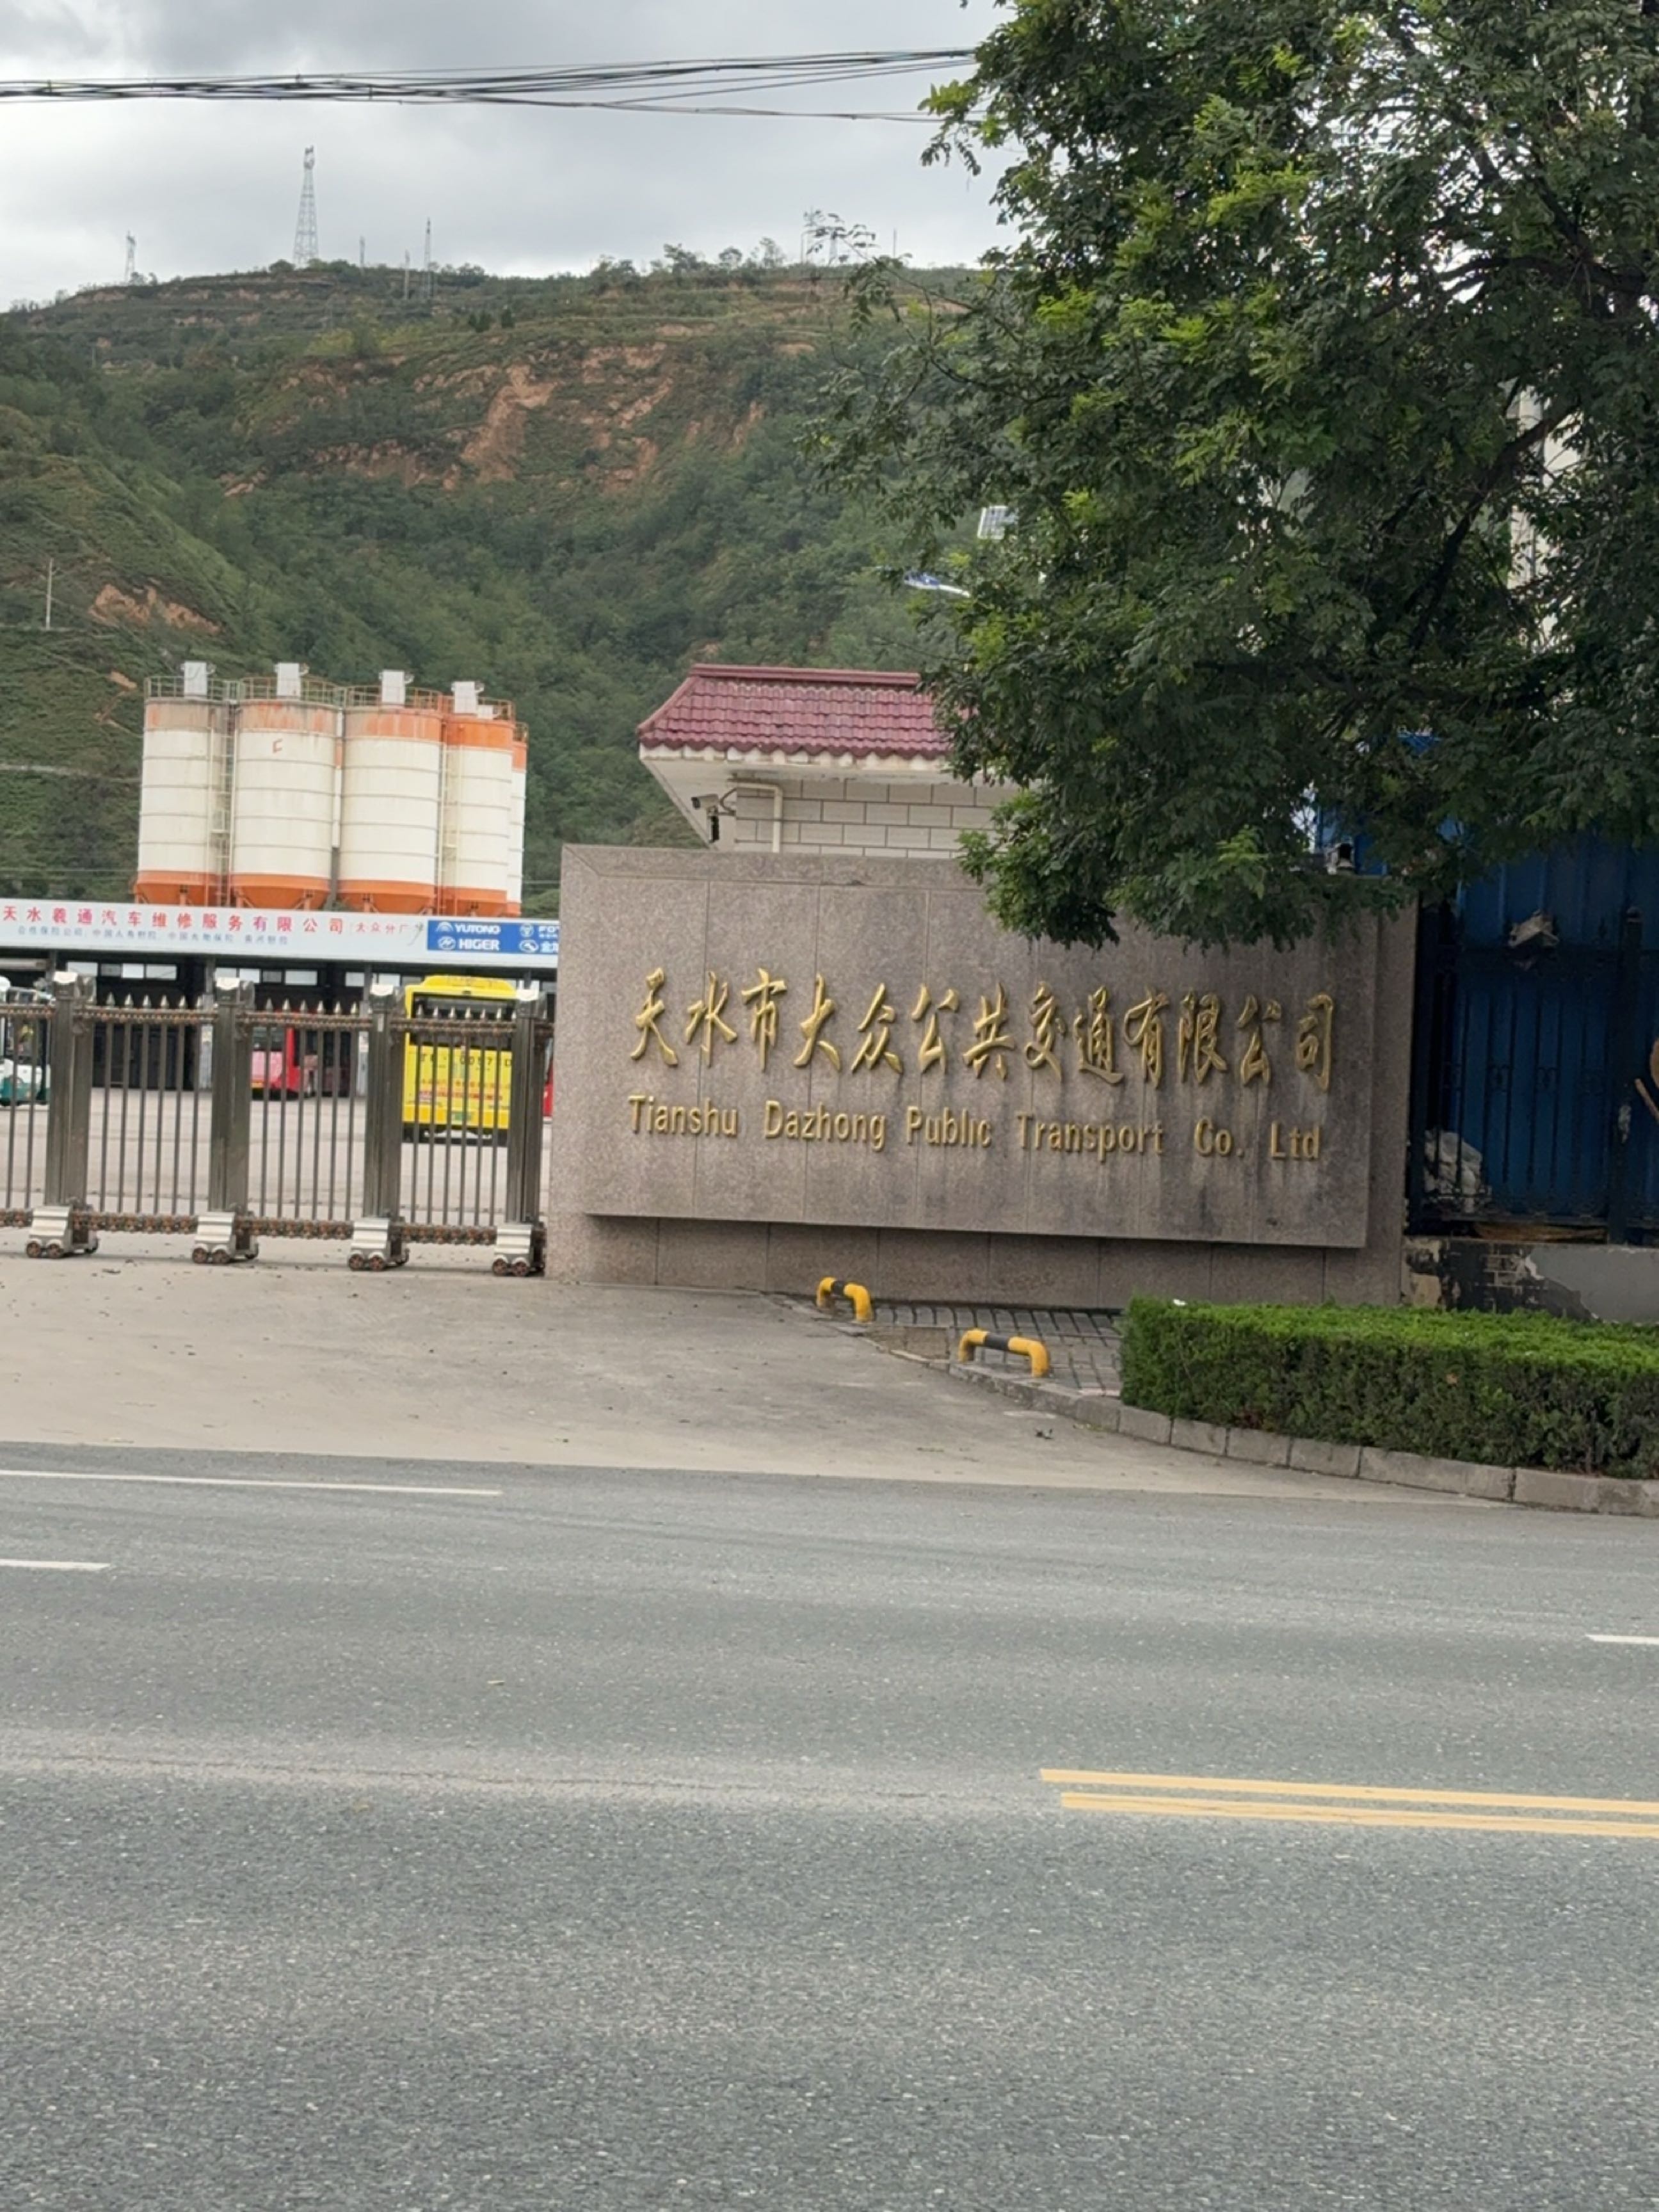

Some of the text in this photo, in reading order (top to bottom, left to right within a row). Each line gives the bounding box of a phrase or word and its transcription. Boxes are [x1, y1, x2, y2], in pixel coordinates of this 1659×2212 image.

[459, 938, 500, 951] HIGER
[630, 967, 1334, 1092] 天水市大众公共交通有限公司
[629, 1094, 1322, 1162] Tianshu Dazhong Public Transport Co. Ltd
